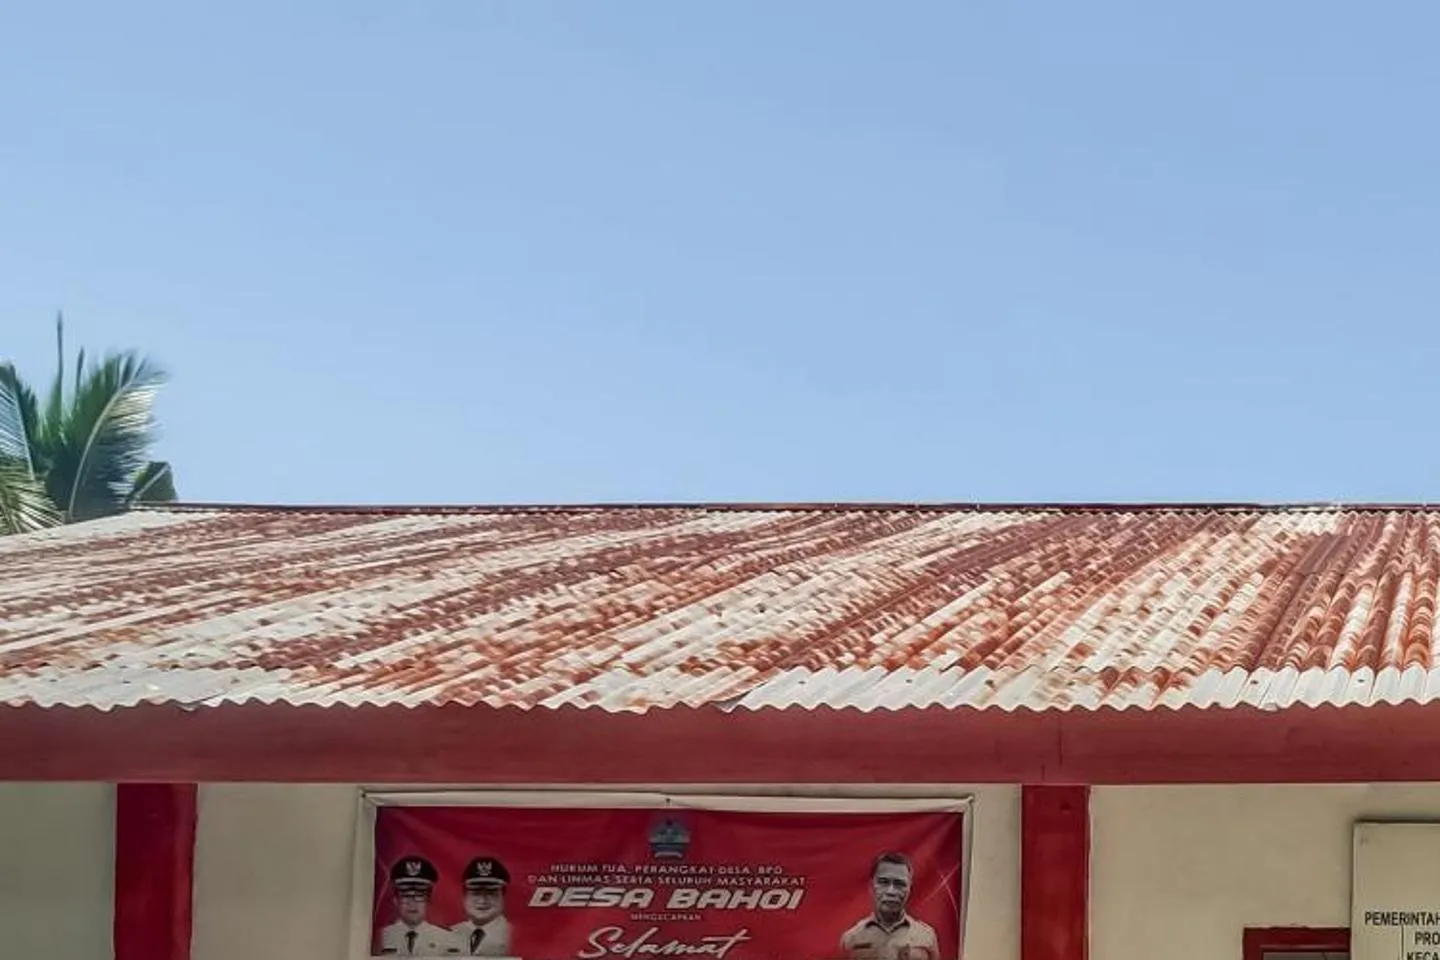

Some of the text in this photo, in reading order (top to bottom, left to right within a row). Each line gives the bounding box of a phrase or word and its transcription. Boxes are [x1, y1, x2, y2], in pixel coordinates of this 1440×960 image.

[717, 877, 805, 886] MASYARAKAT
[527, 886, 804, 910] DESA BAHOI
[578, 926, 752, 959] Selamat
